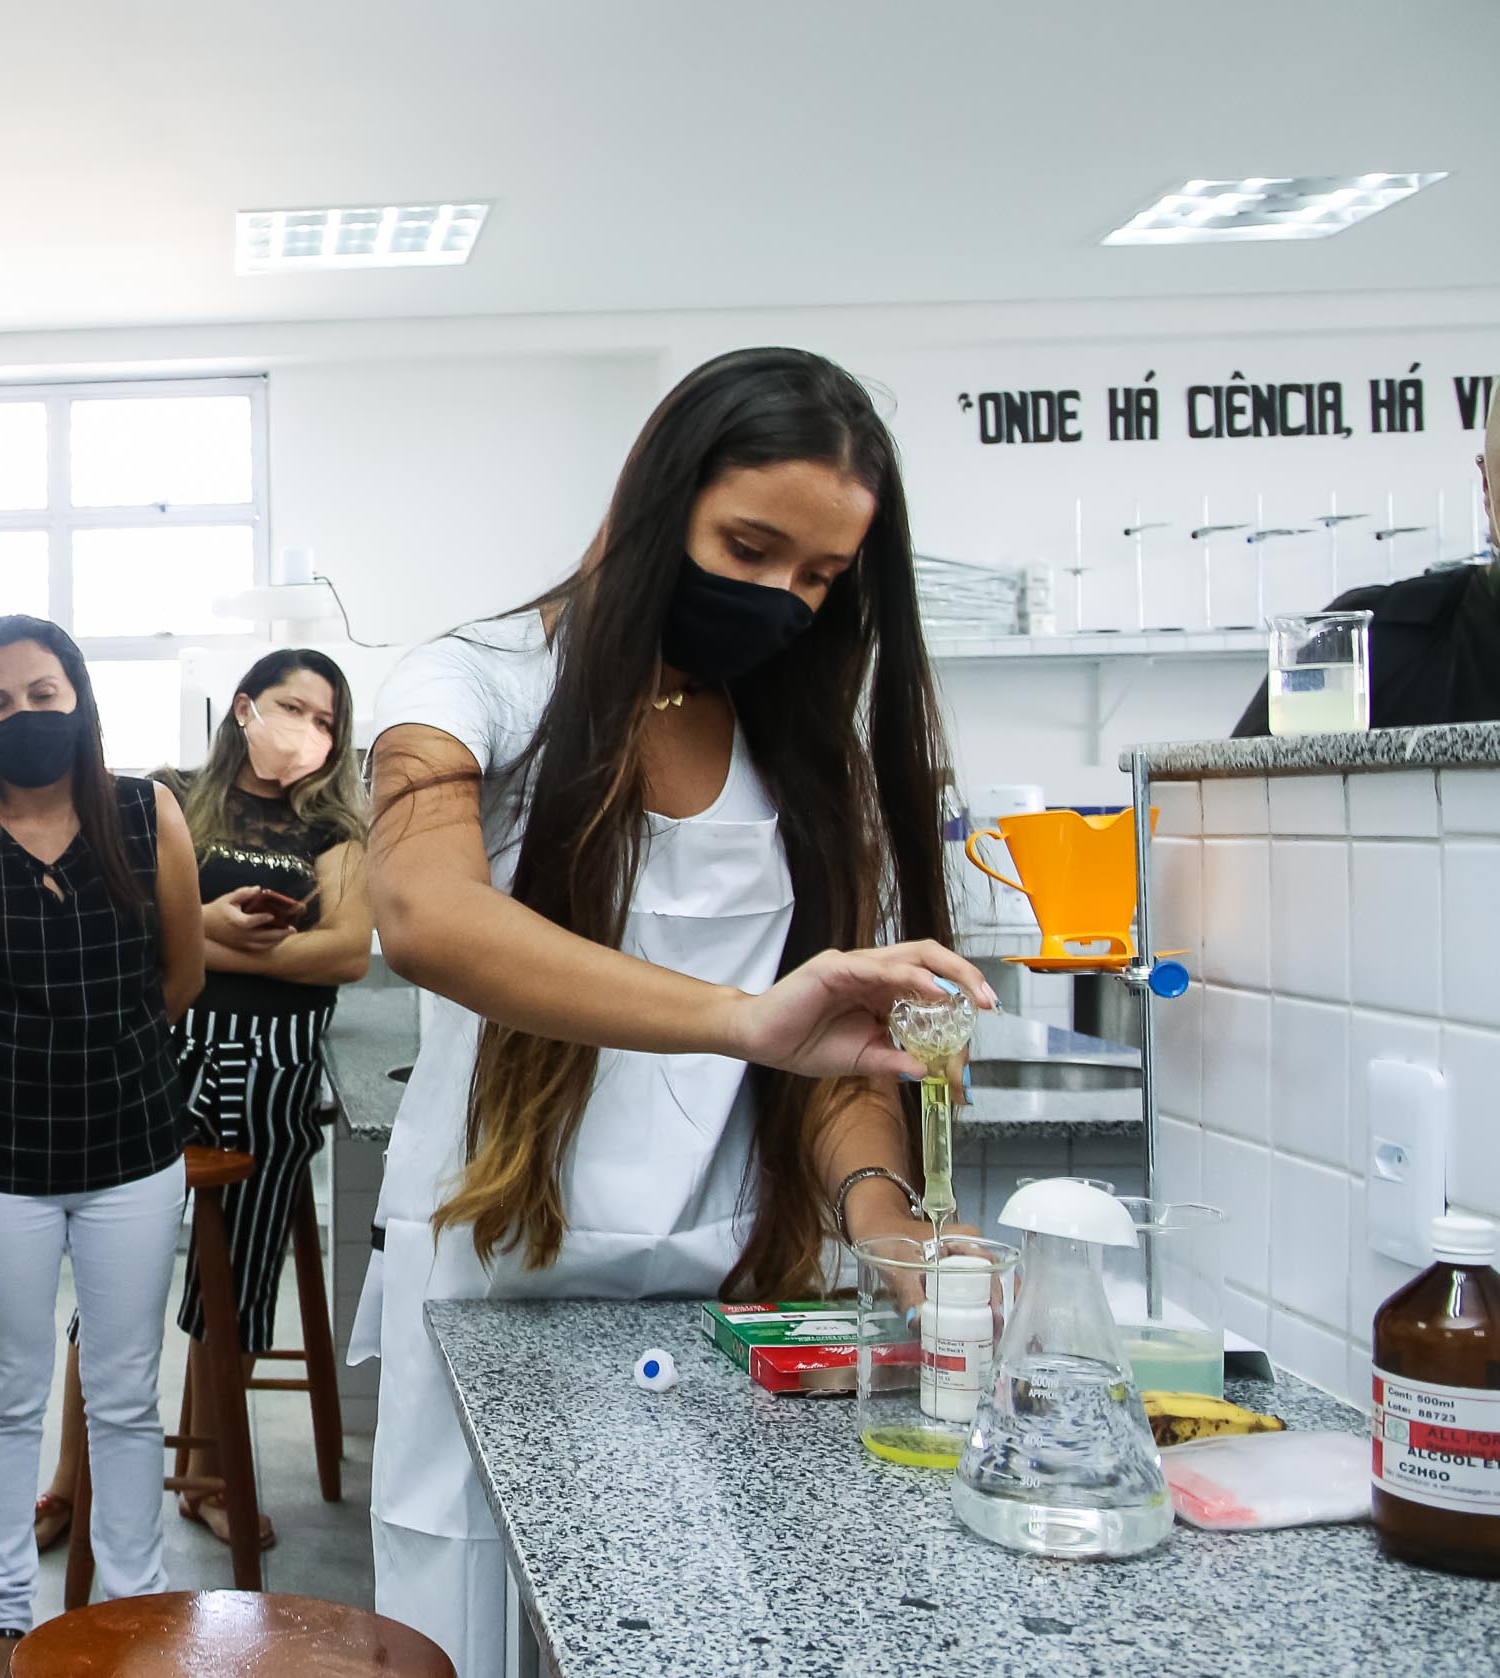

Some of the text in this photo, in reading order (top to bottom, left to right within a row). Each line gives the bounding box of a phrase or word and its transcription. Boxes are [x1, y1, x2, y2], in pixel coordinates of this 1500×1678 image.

[1107, 371, 1159, 441] HÁ
[1186, 370, 1353, 440] CIÊNCIA,
[1369, 362, 1424, 433] HÁ
[1388, 1386, 1455, 1409] Cont: 500ml
[1418, 1409, 1457, 1424] 88723
[1428, 1427, 1461, 1443] ALL
[1407, 1446, 1477, 1468] ALCOOL
[1398, 1461, 1451, 1482] C2H6O
